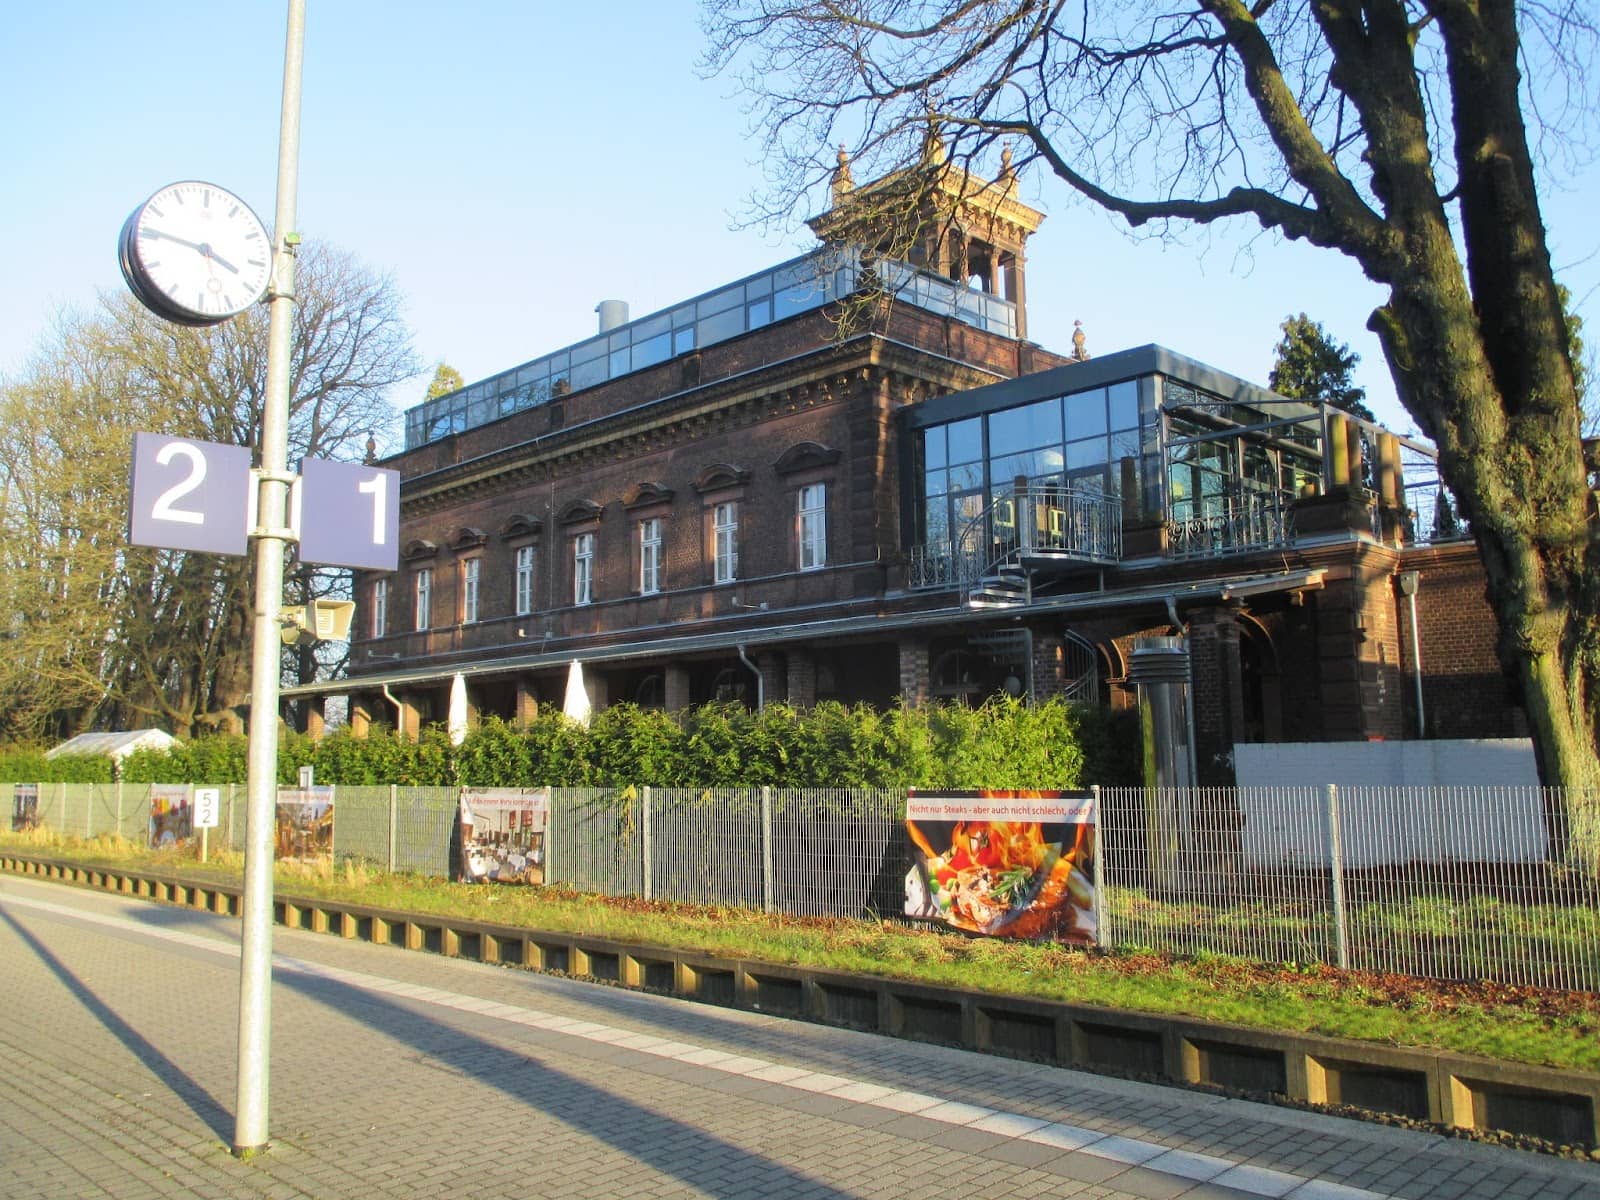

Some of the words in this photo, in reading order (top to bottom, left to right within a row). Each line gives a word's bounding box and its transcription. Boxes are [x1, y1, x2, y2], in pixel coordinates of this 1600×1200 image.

[151, 441, 207, 525] 2
[359, 473, 387, 545] 1
[203, 792, 211, 807] 5
[203, 809, 211, 824] 2
[909, 804, 929, 814] Nicht
[930, 806, 942, 814] nur
[944, 804, 968, 814] Steaks
[973, 805, 990, 814] aber
[991, 805, 1009, 815] auch
[1011, 805, 1030, 815] nicht
[1032, 805, 1067, 816] schlecht,
[1069, 806, 1087, 816] oder
